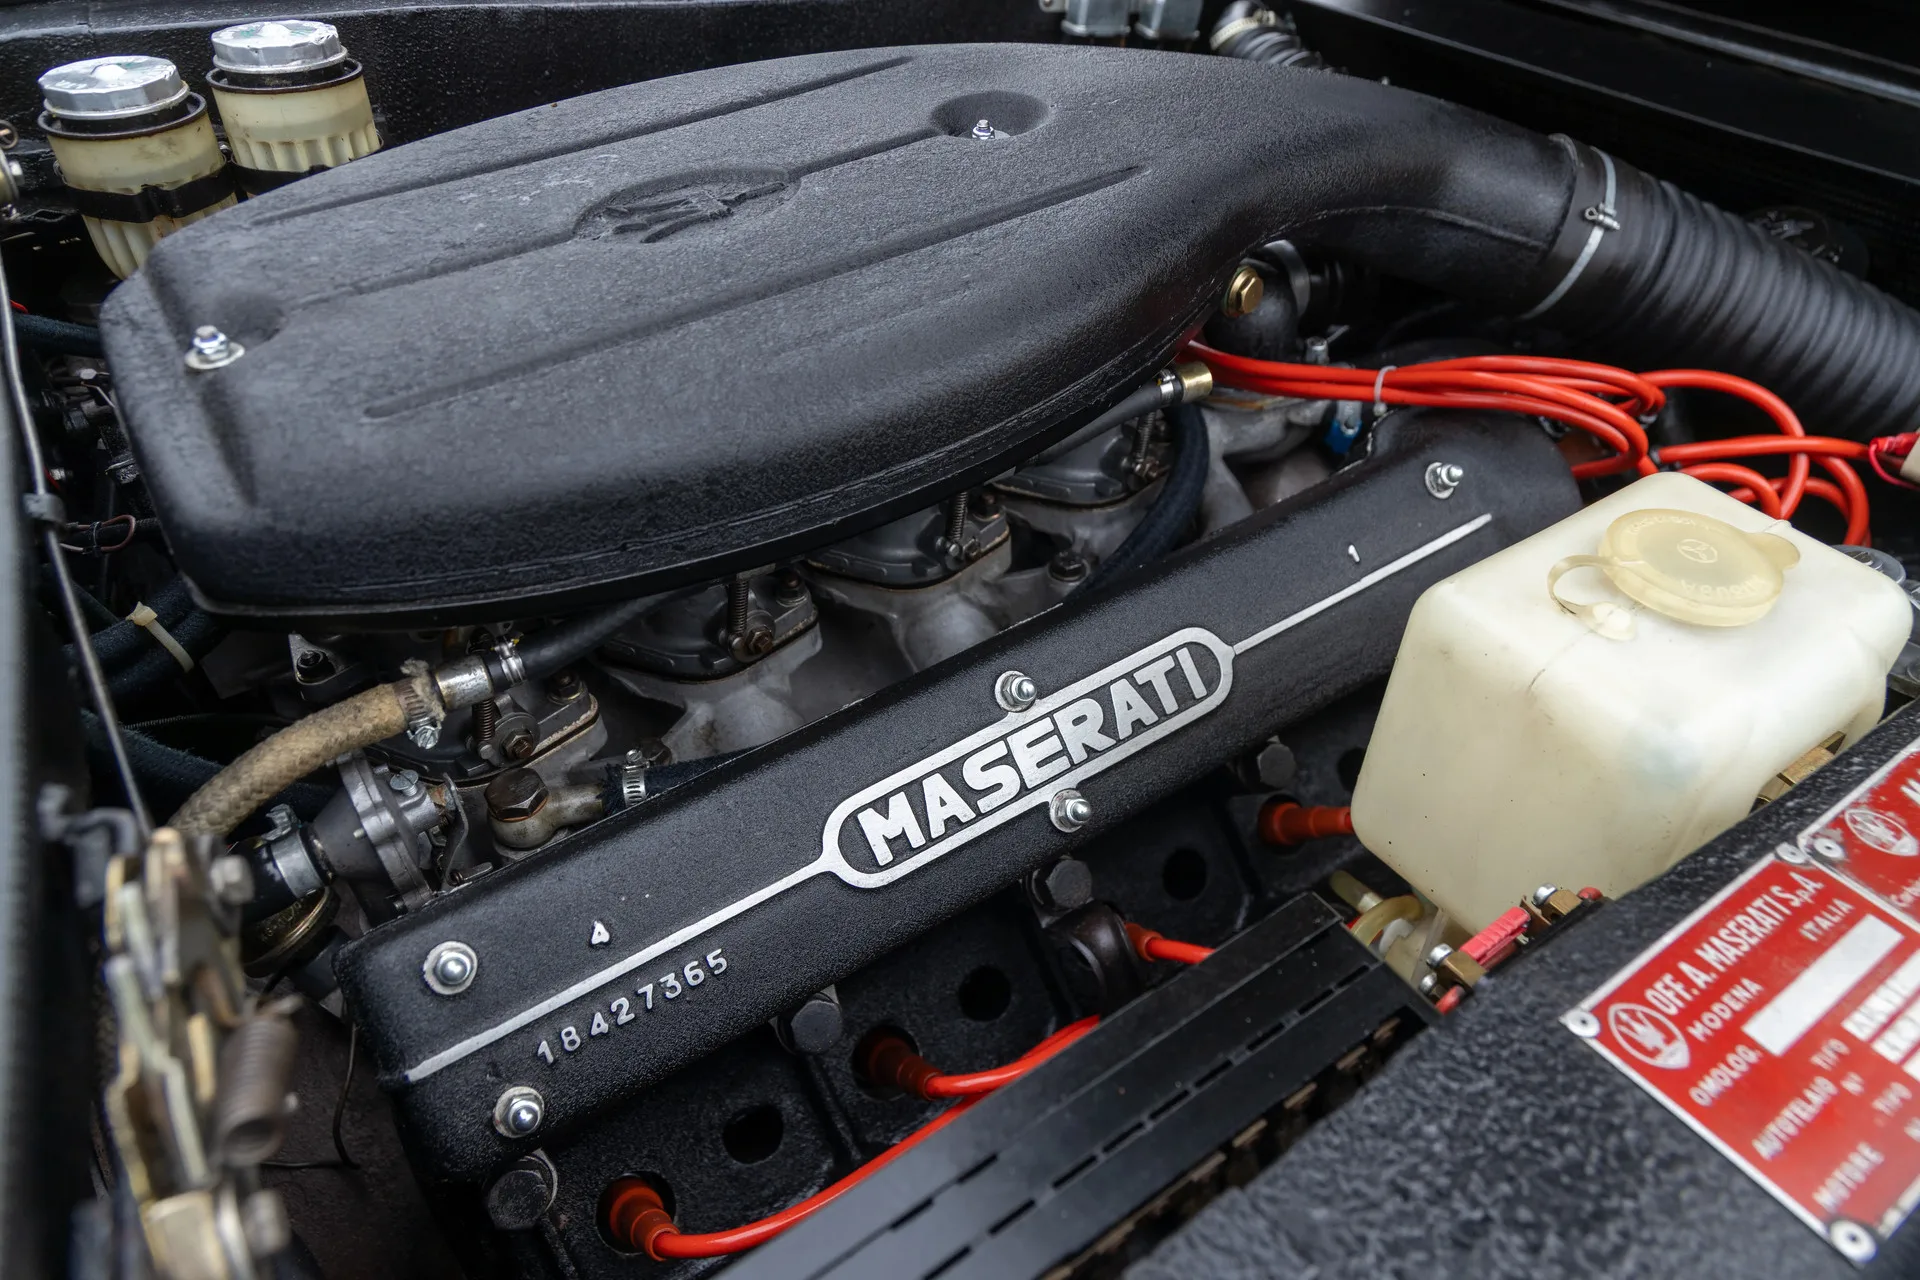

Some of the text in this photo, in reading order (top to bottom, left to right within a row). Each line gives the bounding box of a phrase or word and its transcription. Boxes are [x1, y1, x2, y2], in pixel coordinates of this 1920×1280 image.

[1348, 545, 1360, 562] 1
[858, 647, 1207, 866] MASERATI
[1687, 897, 1854, 1042] MODENA ITALIA
[1695, 894, 1792, 972] MASERATI
[537, 949, 727, 1064] 18427365
[1644, 972, 1700, 1015] OFF.
[1677, 961, 1718, 989] A.
[1752, 1076, 1839, 1161] AUTOTELAIO
[1812, 1141, 1885, 1213] MOTORE
